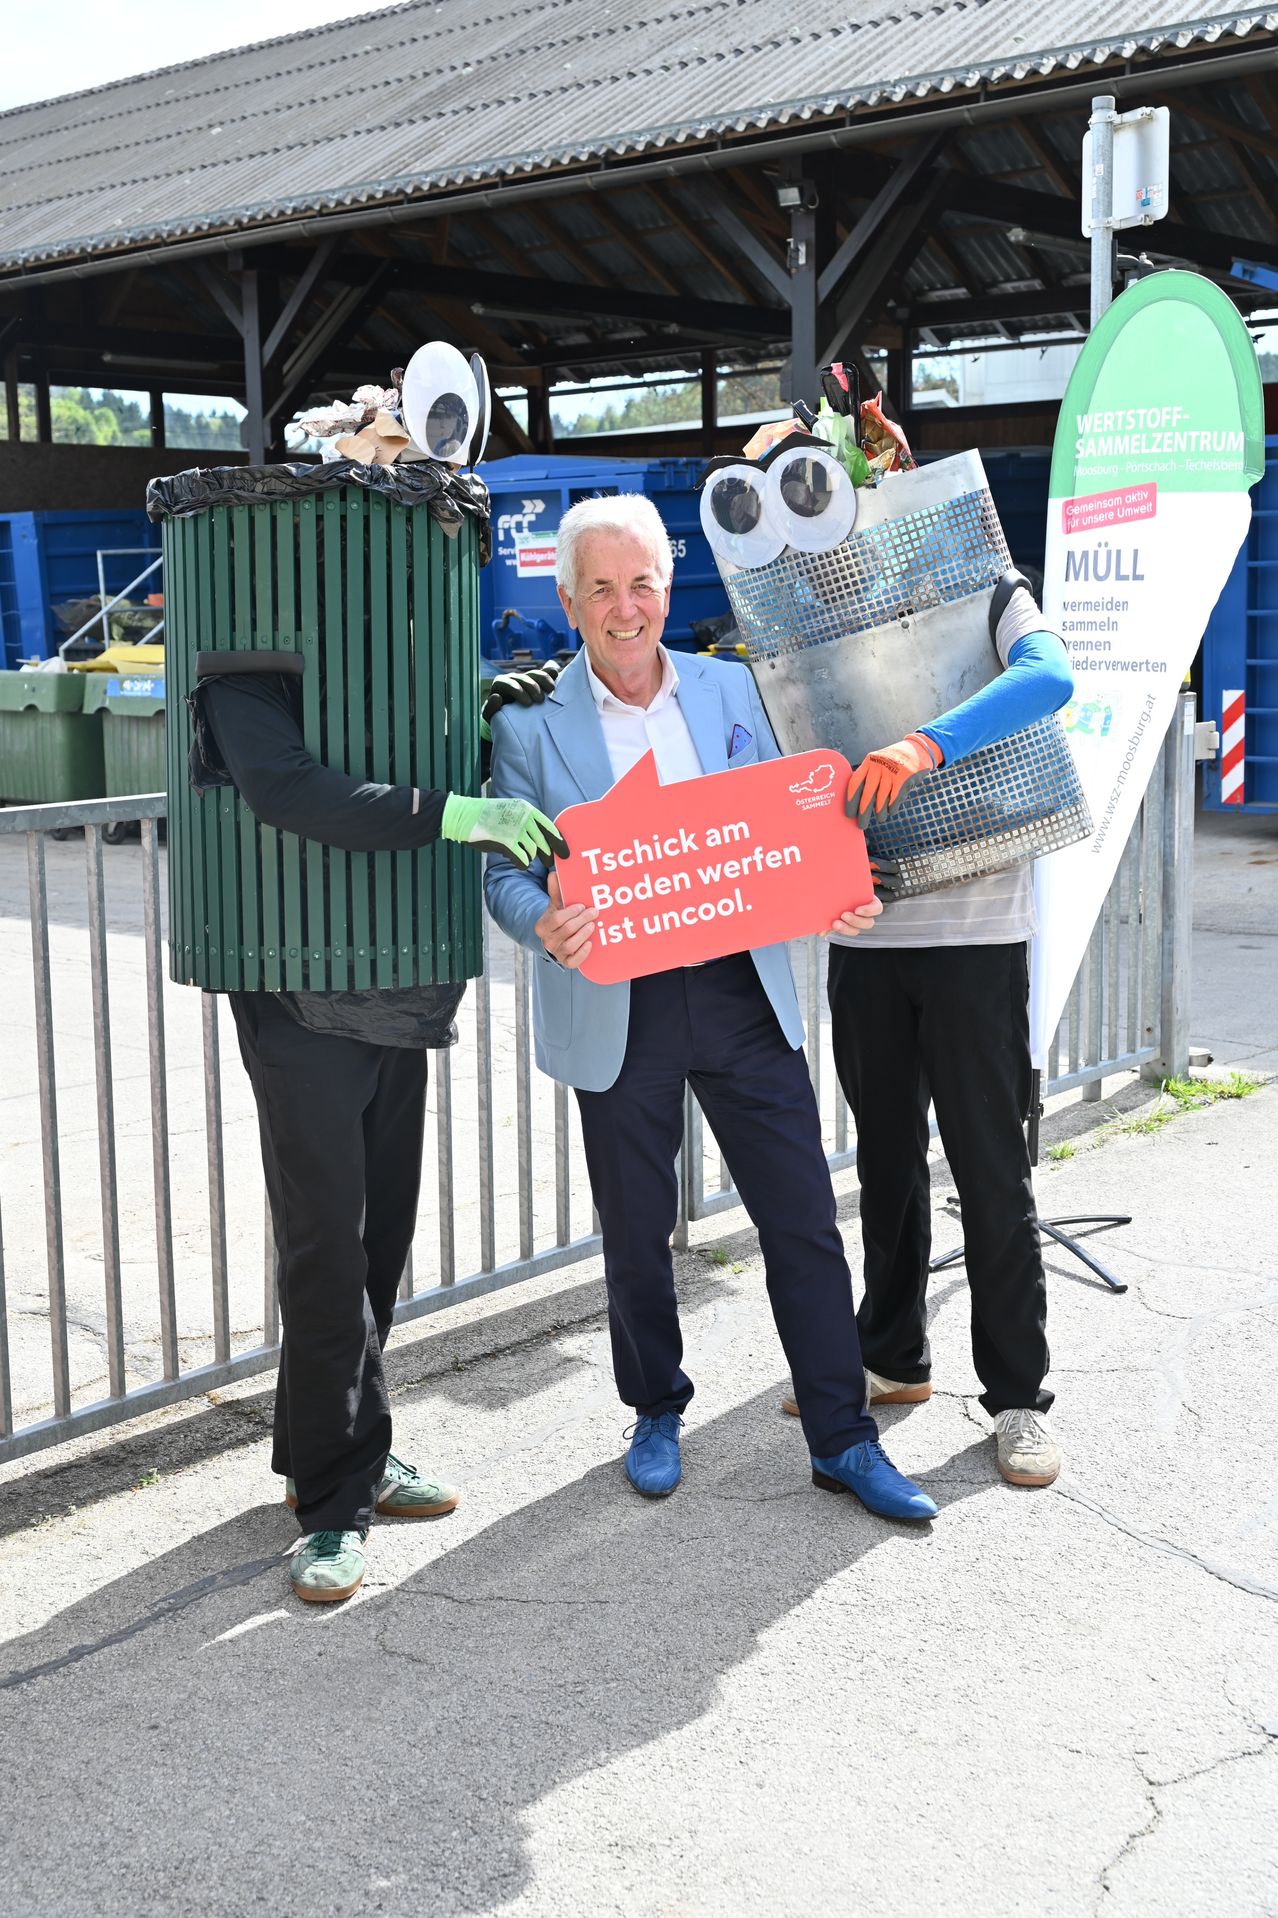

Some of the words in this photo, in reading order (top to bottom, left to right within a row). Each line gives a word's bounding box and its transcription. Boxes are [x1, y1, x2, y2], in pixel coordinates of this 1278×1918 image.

[1076, 406, 1190, 435] WERTSTOFF-
[1075, 431, 1245, 459] SAMMELZENTRUM
[1073, 463, 1118, 477] Moosburg
[1066, 496, 1122, 516] Gemeinsam
[1125, 489, 1149, 504] aktiv
[1067, 515, 1080, 531] für
[1082, 511, 1114, 526] unsere
[1117, 501, 1153, 518] Umwelt
[1065, 541, 1145, 582] MÜLL
[1063, 596, 1129, 612] vermeiden
[1062, 616, 1119, 632] sammeln
[1067, 639, 1111, 651] rennen
[1070, 656, 1167, 673] iederverwerten
[1091, 692, 1157, 855] www.wsz-moosburg.at
[795, 791, 836, 806] ÖSTERREICH
[801, 798, 832, 811] SAMMELT
[581, 828, 700, 876] Tschick
[705, 820, 751, 845] am
[590, 870, 693, 911] Boden
[696, 844, 802, 887] werfen
[597, 919, 637, 946] ist
[642, 887, 753, 935] uncool.
